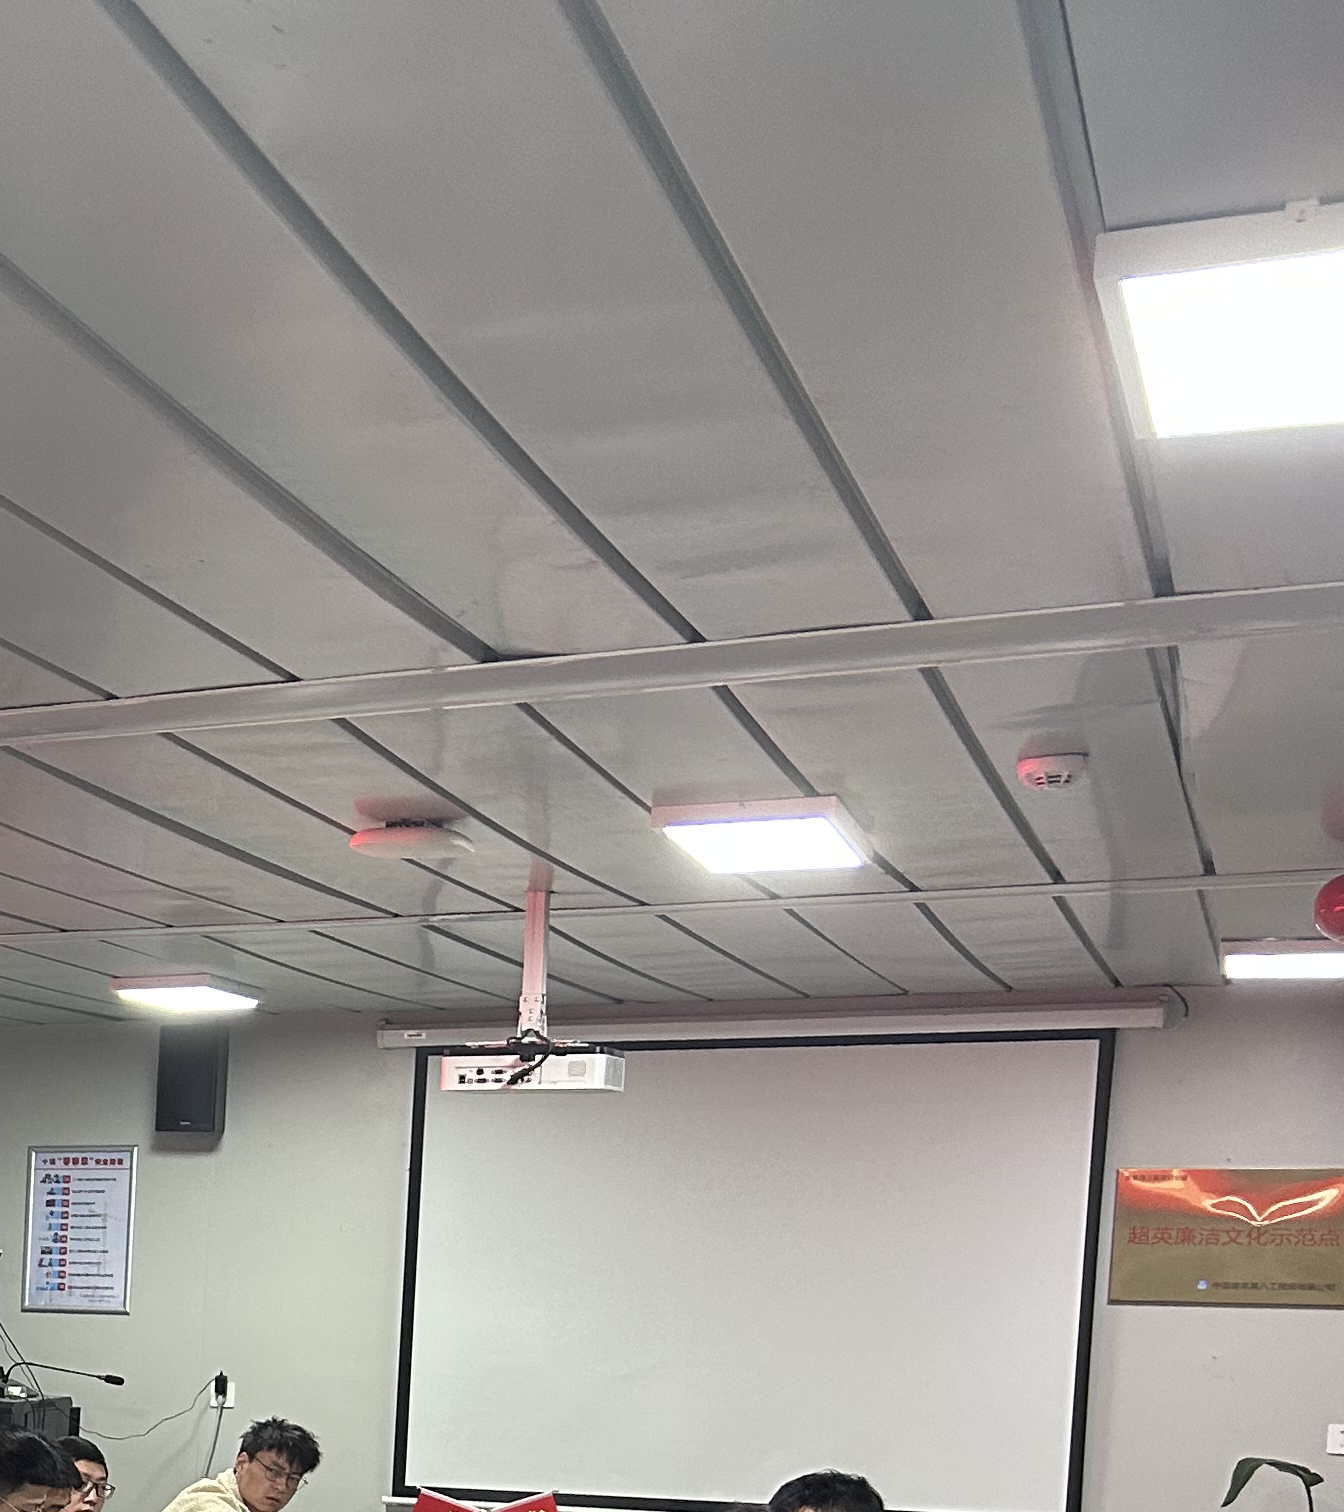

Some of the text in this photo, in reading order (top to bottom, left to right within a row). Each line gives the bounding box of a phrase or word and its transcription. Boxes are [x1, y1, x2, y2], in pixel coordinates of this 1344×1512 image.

[1127, 1226, 1341, 1248] 超英廉洁文化示范点
